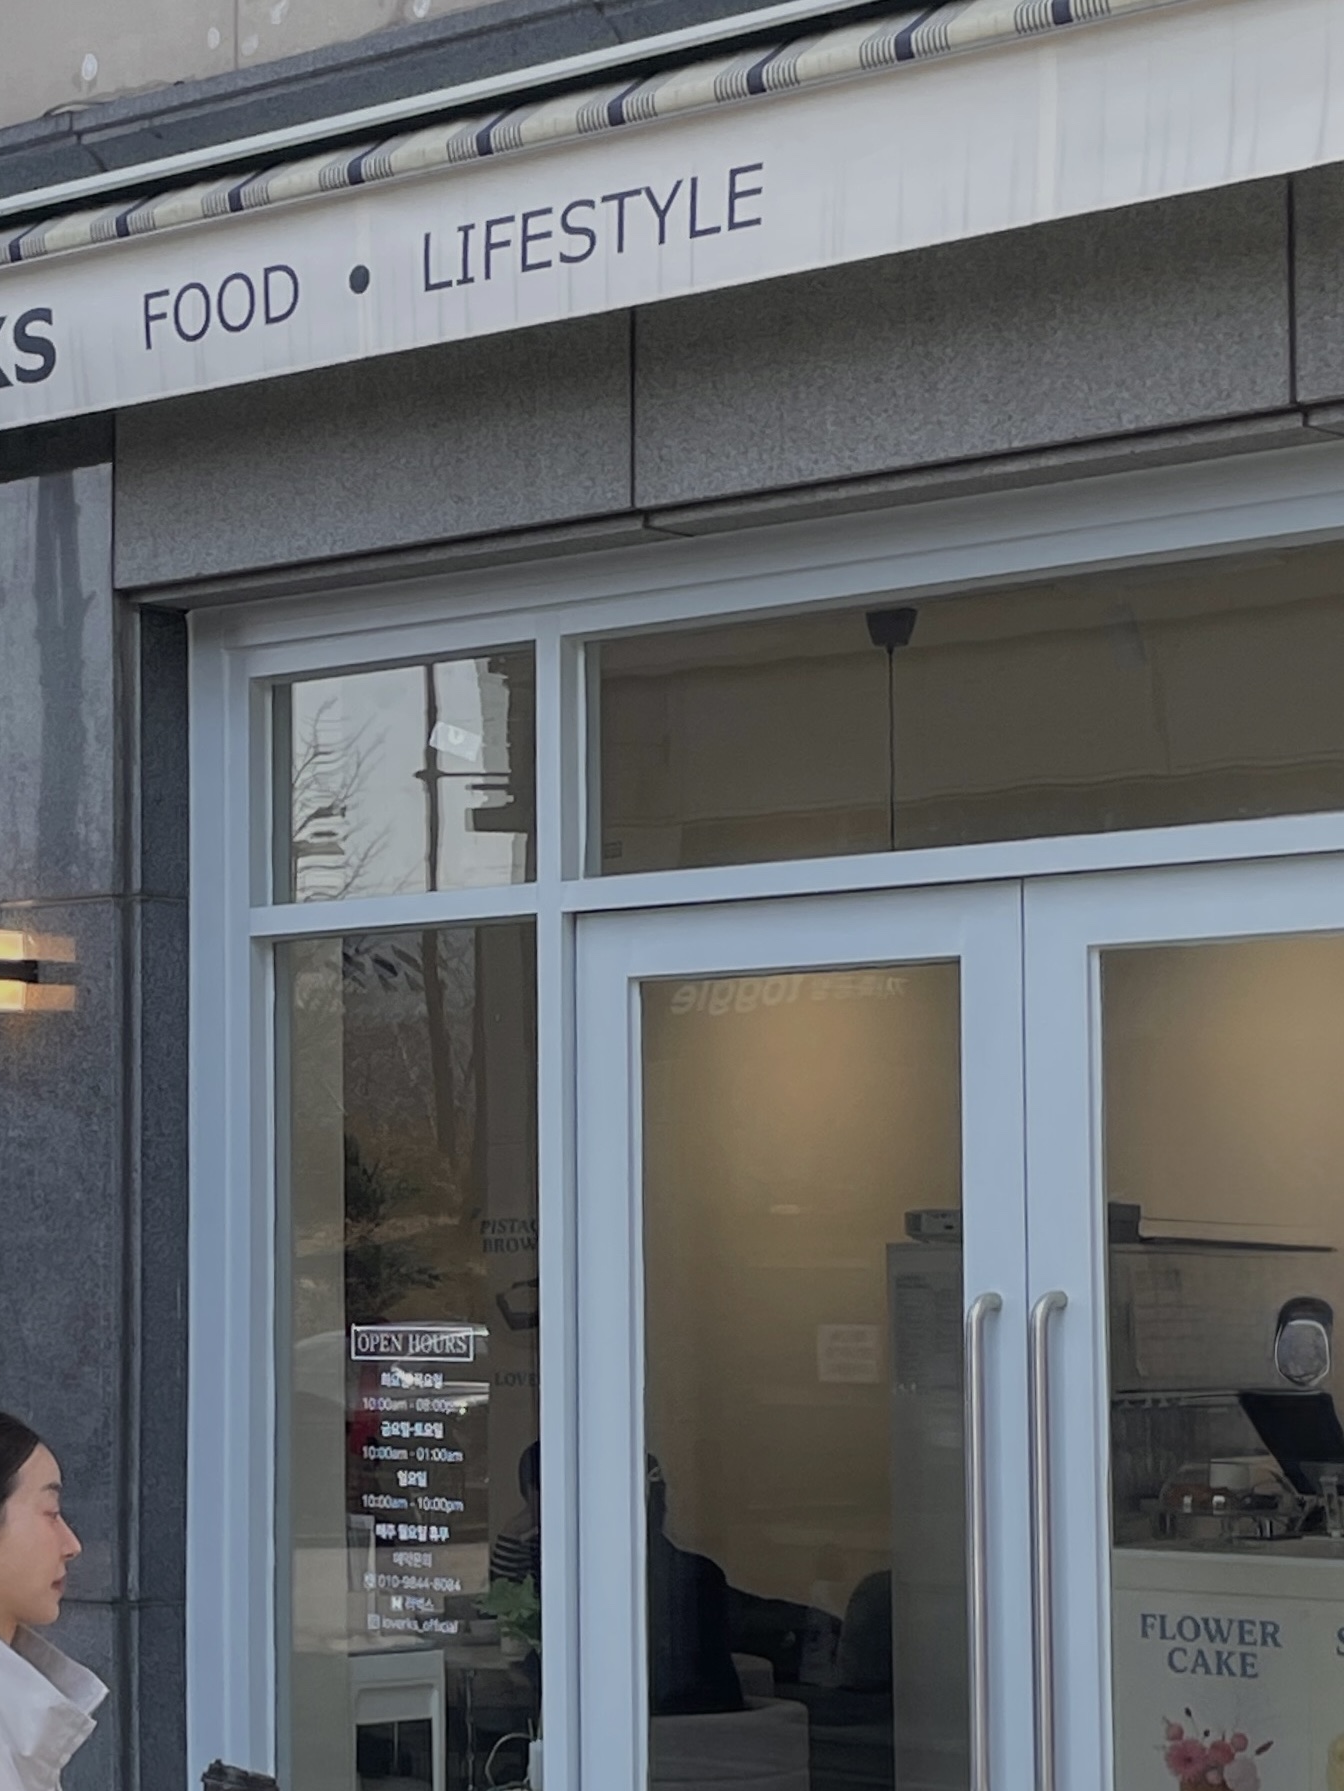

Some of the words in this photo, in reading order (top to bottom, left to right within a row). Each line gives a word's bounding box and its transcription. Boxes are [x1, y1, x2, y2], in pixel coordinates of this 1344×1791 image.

[143, 263, 300, 351] FOOD
[423, 162, 764, 292] LIFESTYLE
[357, 1333, 403, 1353] OPEN
[408, 1333, 468, 1354] HOURS
[362, 1494, 408, 1509] 10:00am
[416, 1496, 464, 1513] 10:00pm
[1140, 1612, 1283, 1648] FLOWER
[1167, 1646, 1259, 1679] CAKE
